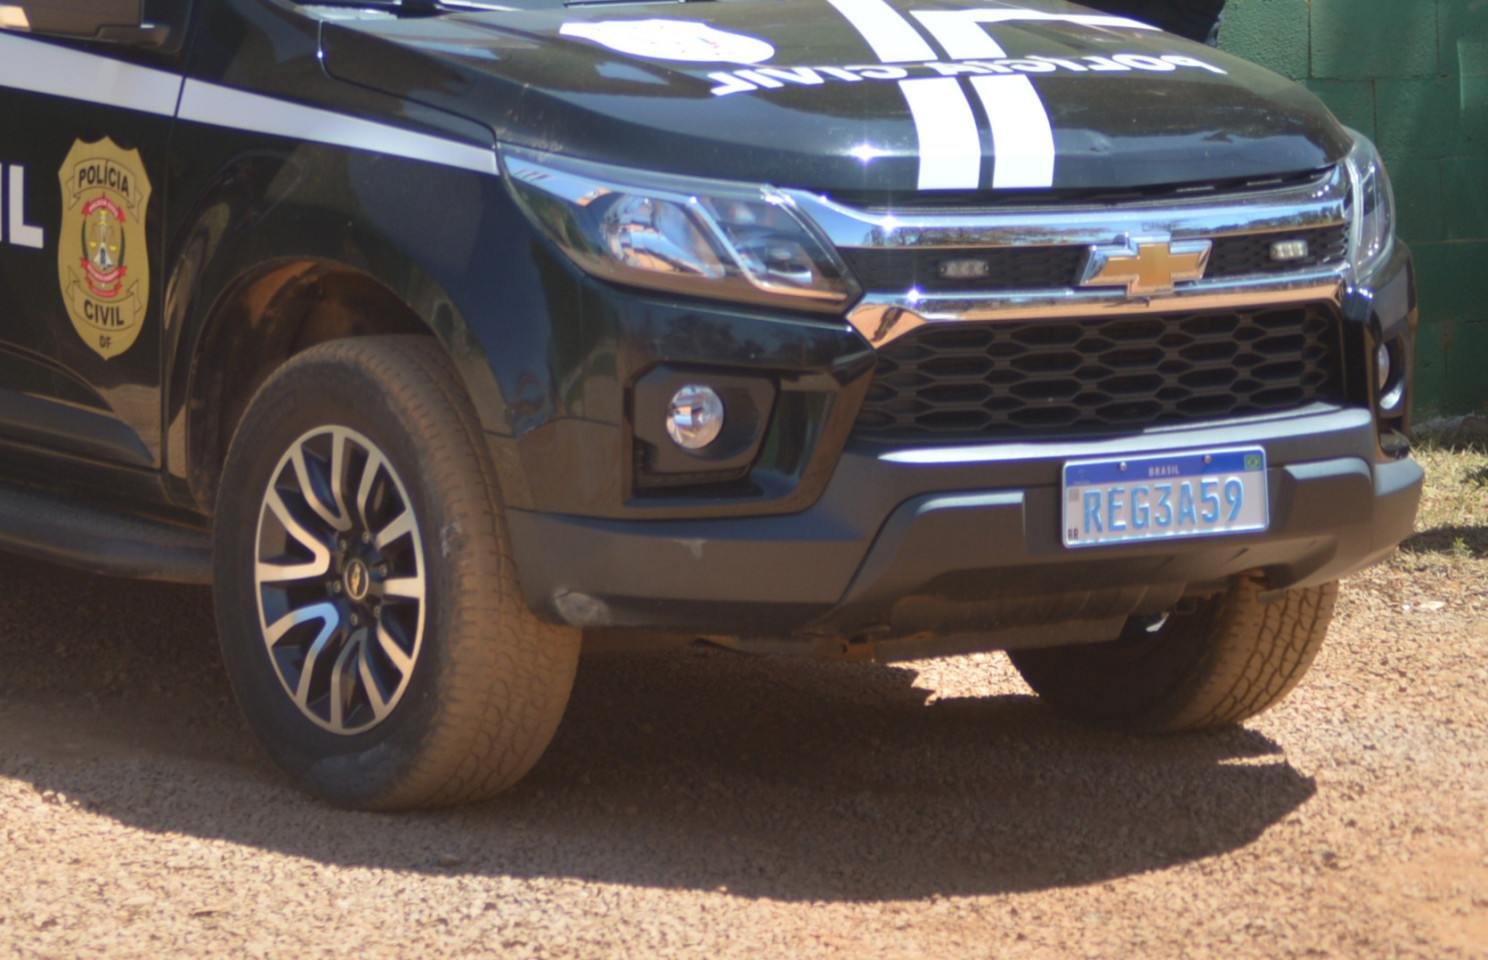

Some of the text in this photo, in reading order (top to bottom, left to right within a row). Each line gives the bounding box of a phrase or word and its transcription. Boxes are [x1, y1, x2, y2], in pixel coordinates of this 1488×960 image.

[78, 159, 129, 195] POLÍCIA
[84, 299, 124, 326] CIVIL
[1148, 465, 1180, 477] BRASIL
[1083, 476, 1244, 533] REG3A59
